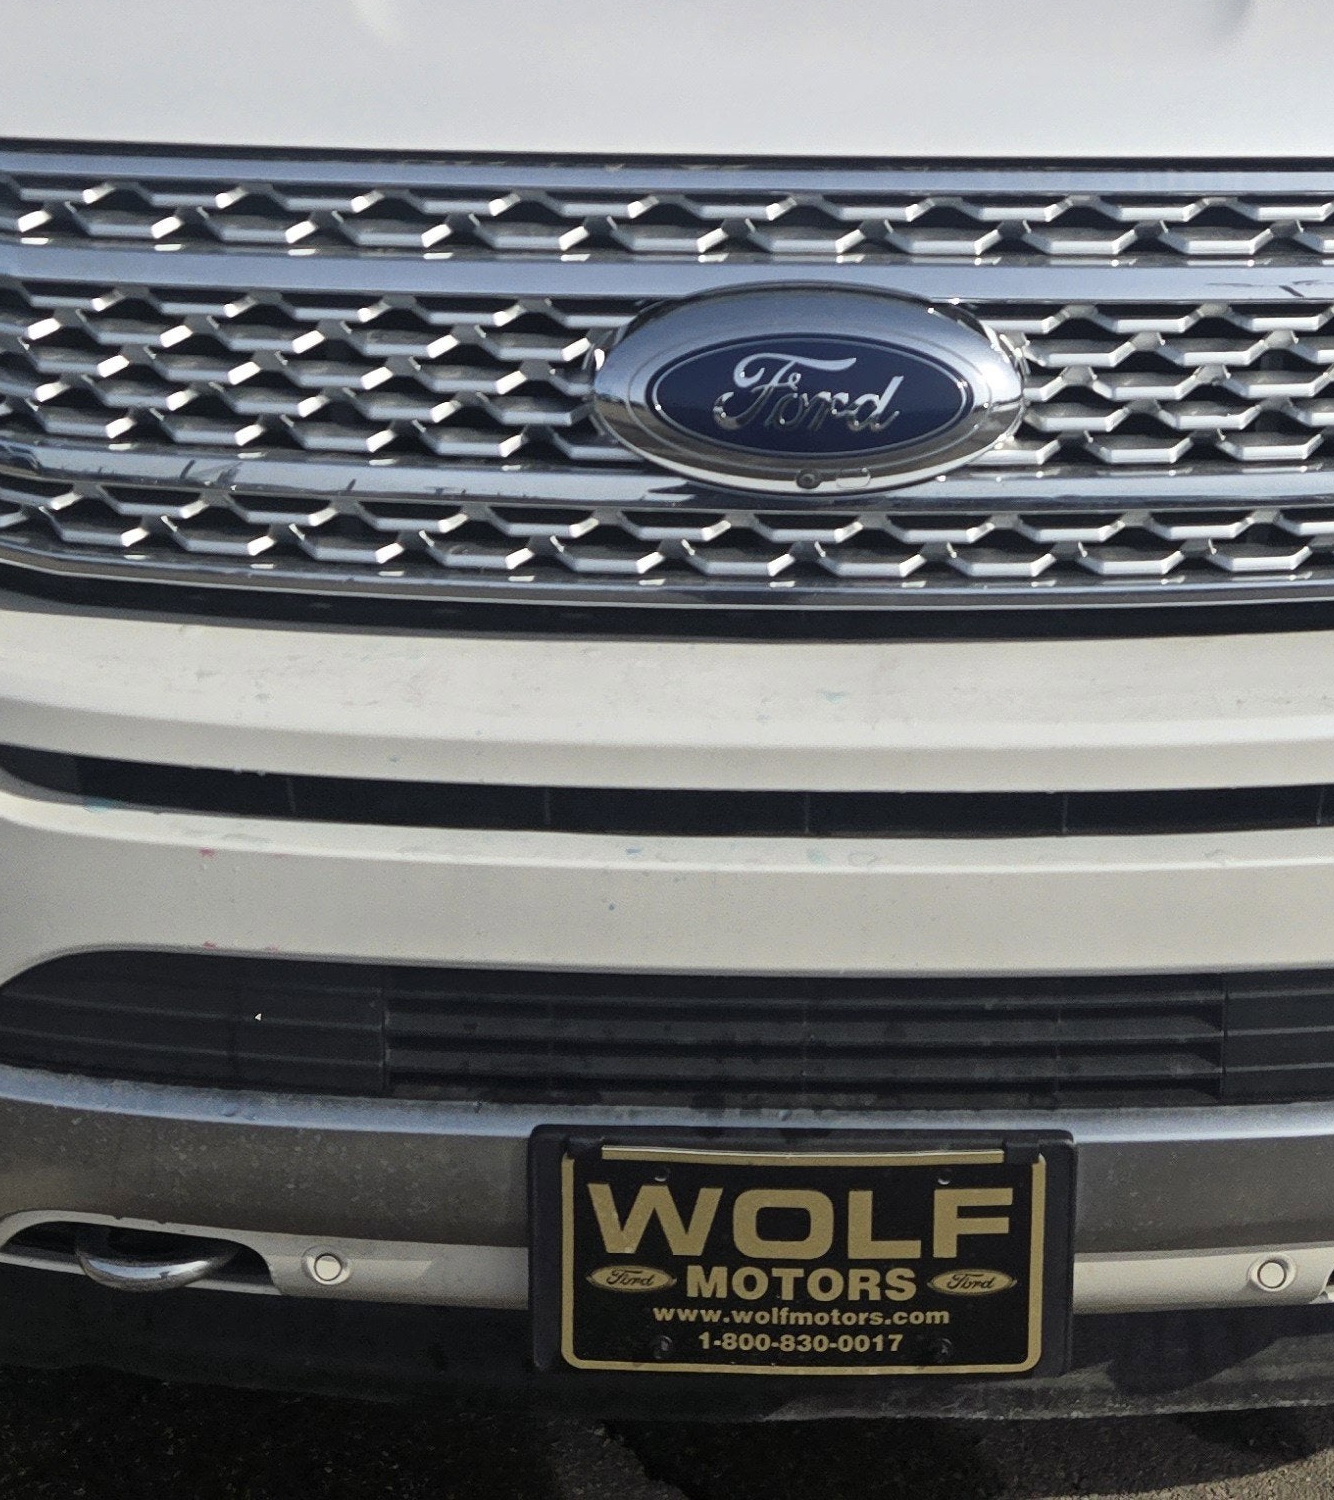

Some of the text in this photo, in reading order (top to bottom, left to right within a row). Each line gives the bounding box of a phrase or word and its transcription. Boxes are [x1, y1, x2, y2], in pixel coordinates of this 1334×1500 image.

[714, 352, 905, 432] Ford
[586, 1182, 1014, 1260] WOLF
[605, 1270, 655, 1287] Ford
[686, 1265, 917, 1302] MOTORS
[945, 1273, 996, 1290] Ford
[653, 1306, 950, 1327] www.wolfmotors.com
[698, 1332, 904, 1353] 1-800-830-0017
